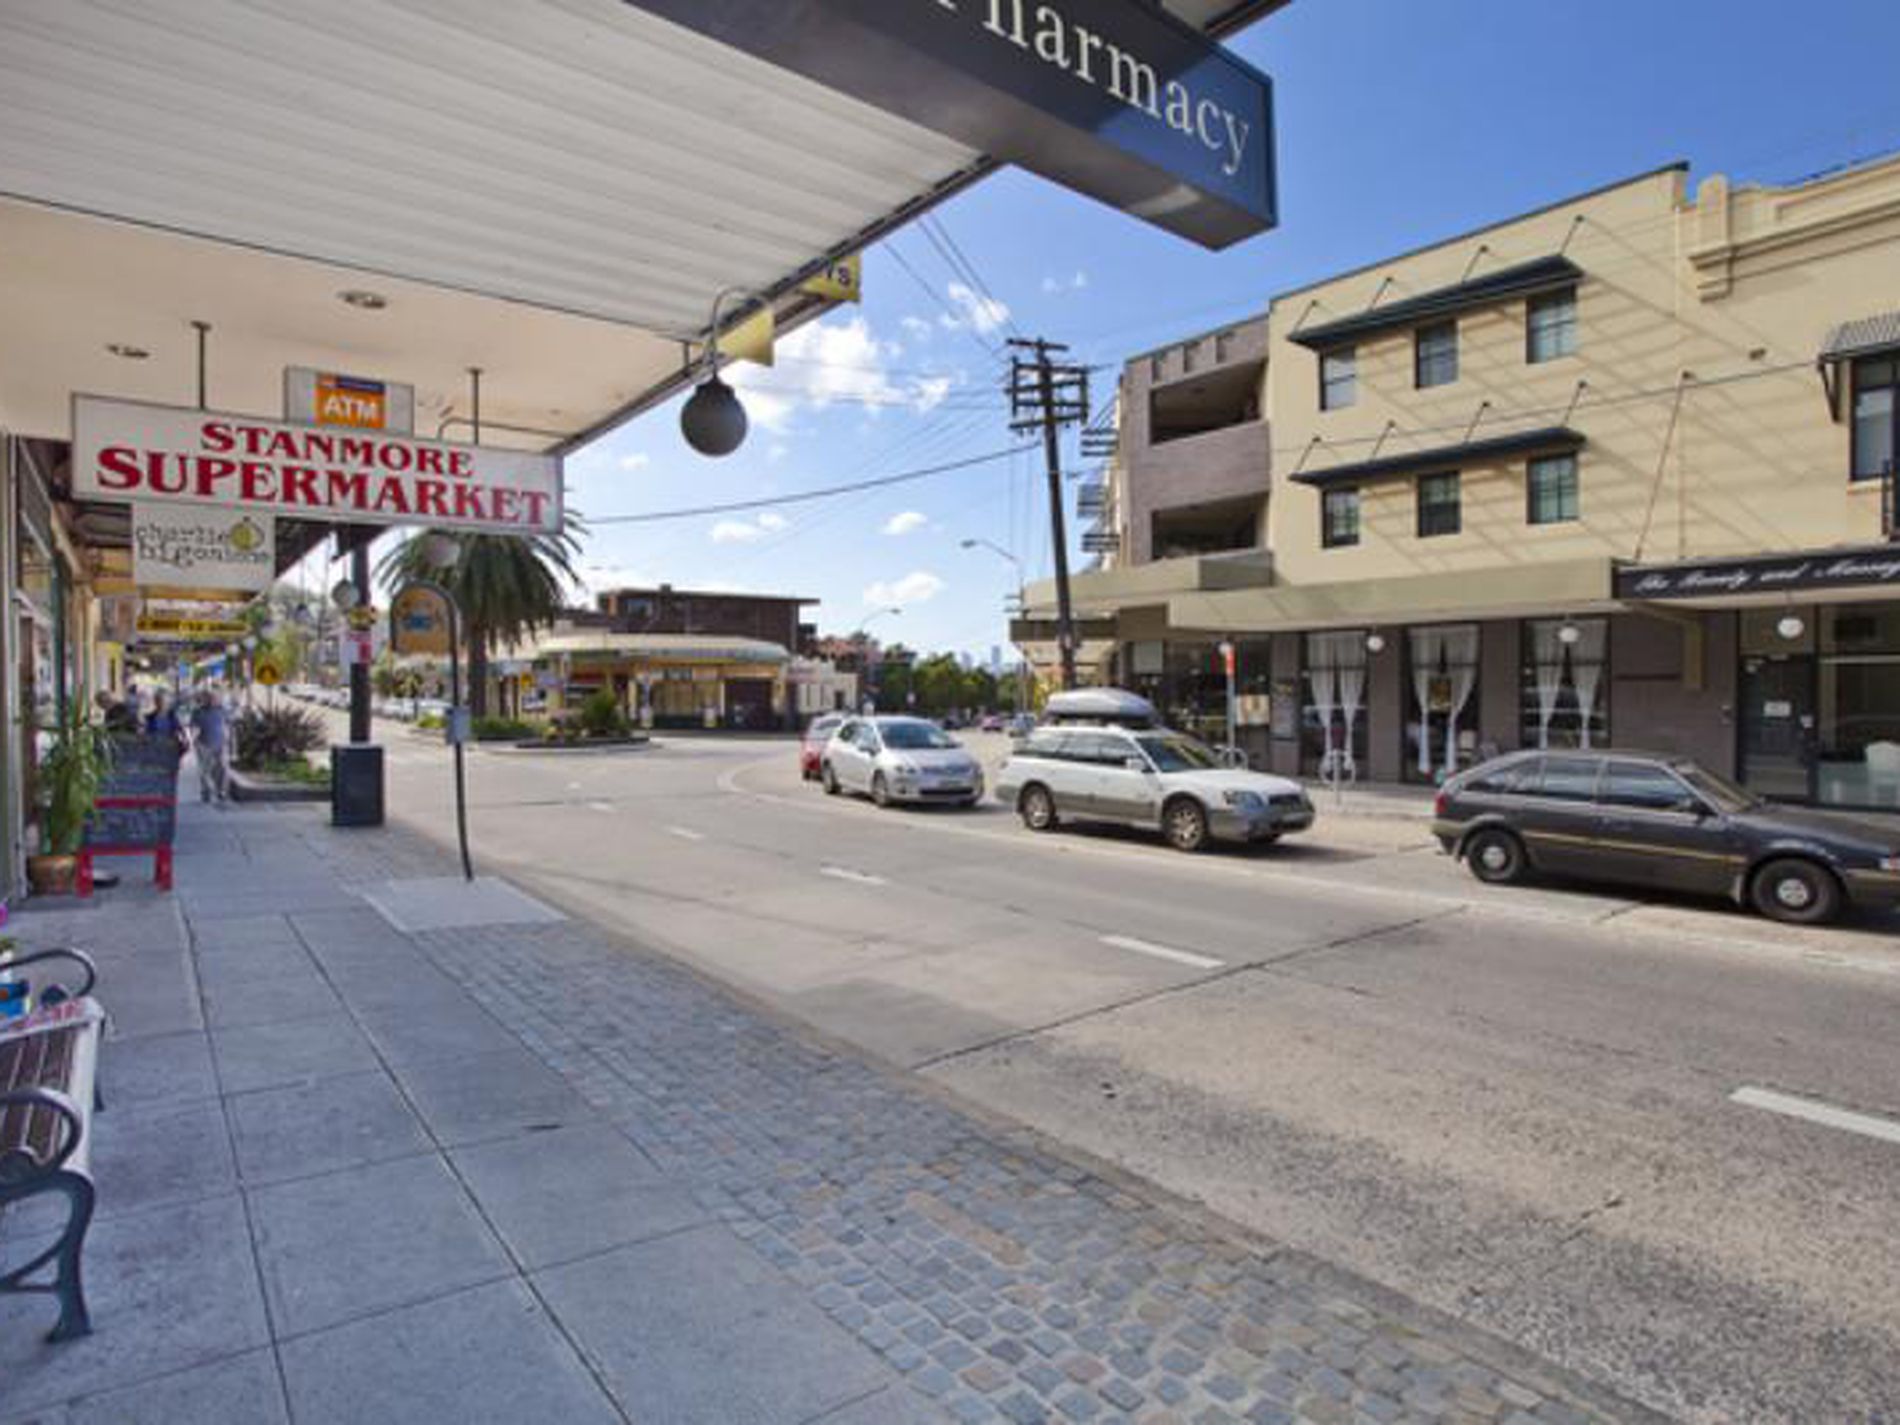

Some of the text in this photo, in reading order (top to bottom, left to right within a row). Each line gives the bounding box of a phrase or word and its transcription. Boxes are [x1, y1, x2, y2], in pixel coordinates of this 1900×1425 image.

[937, 0, 1249, 175] harmacy
[324, 394, 378, 422] ATM
[200, 421, 474, 478] STANMORE
[96, 447, 550, 526] SUPERMARKET
